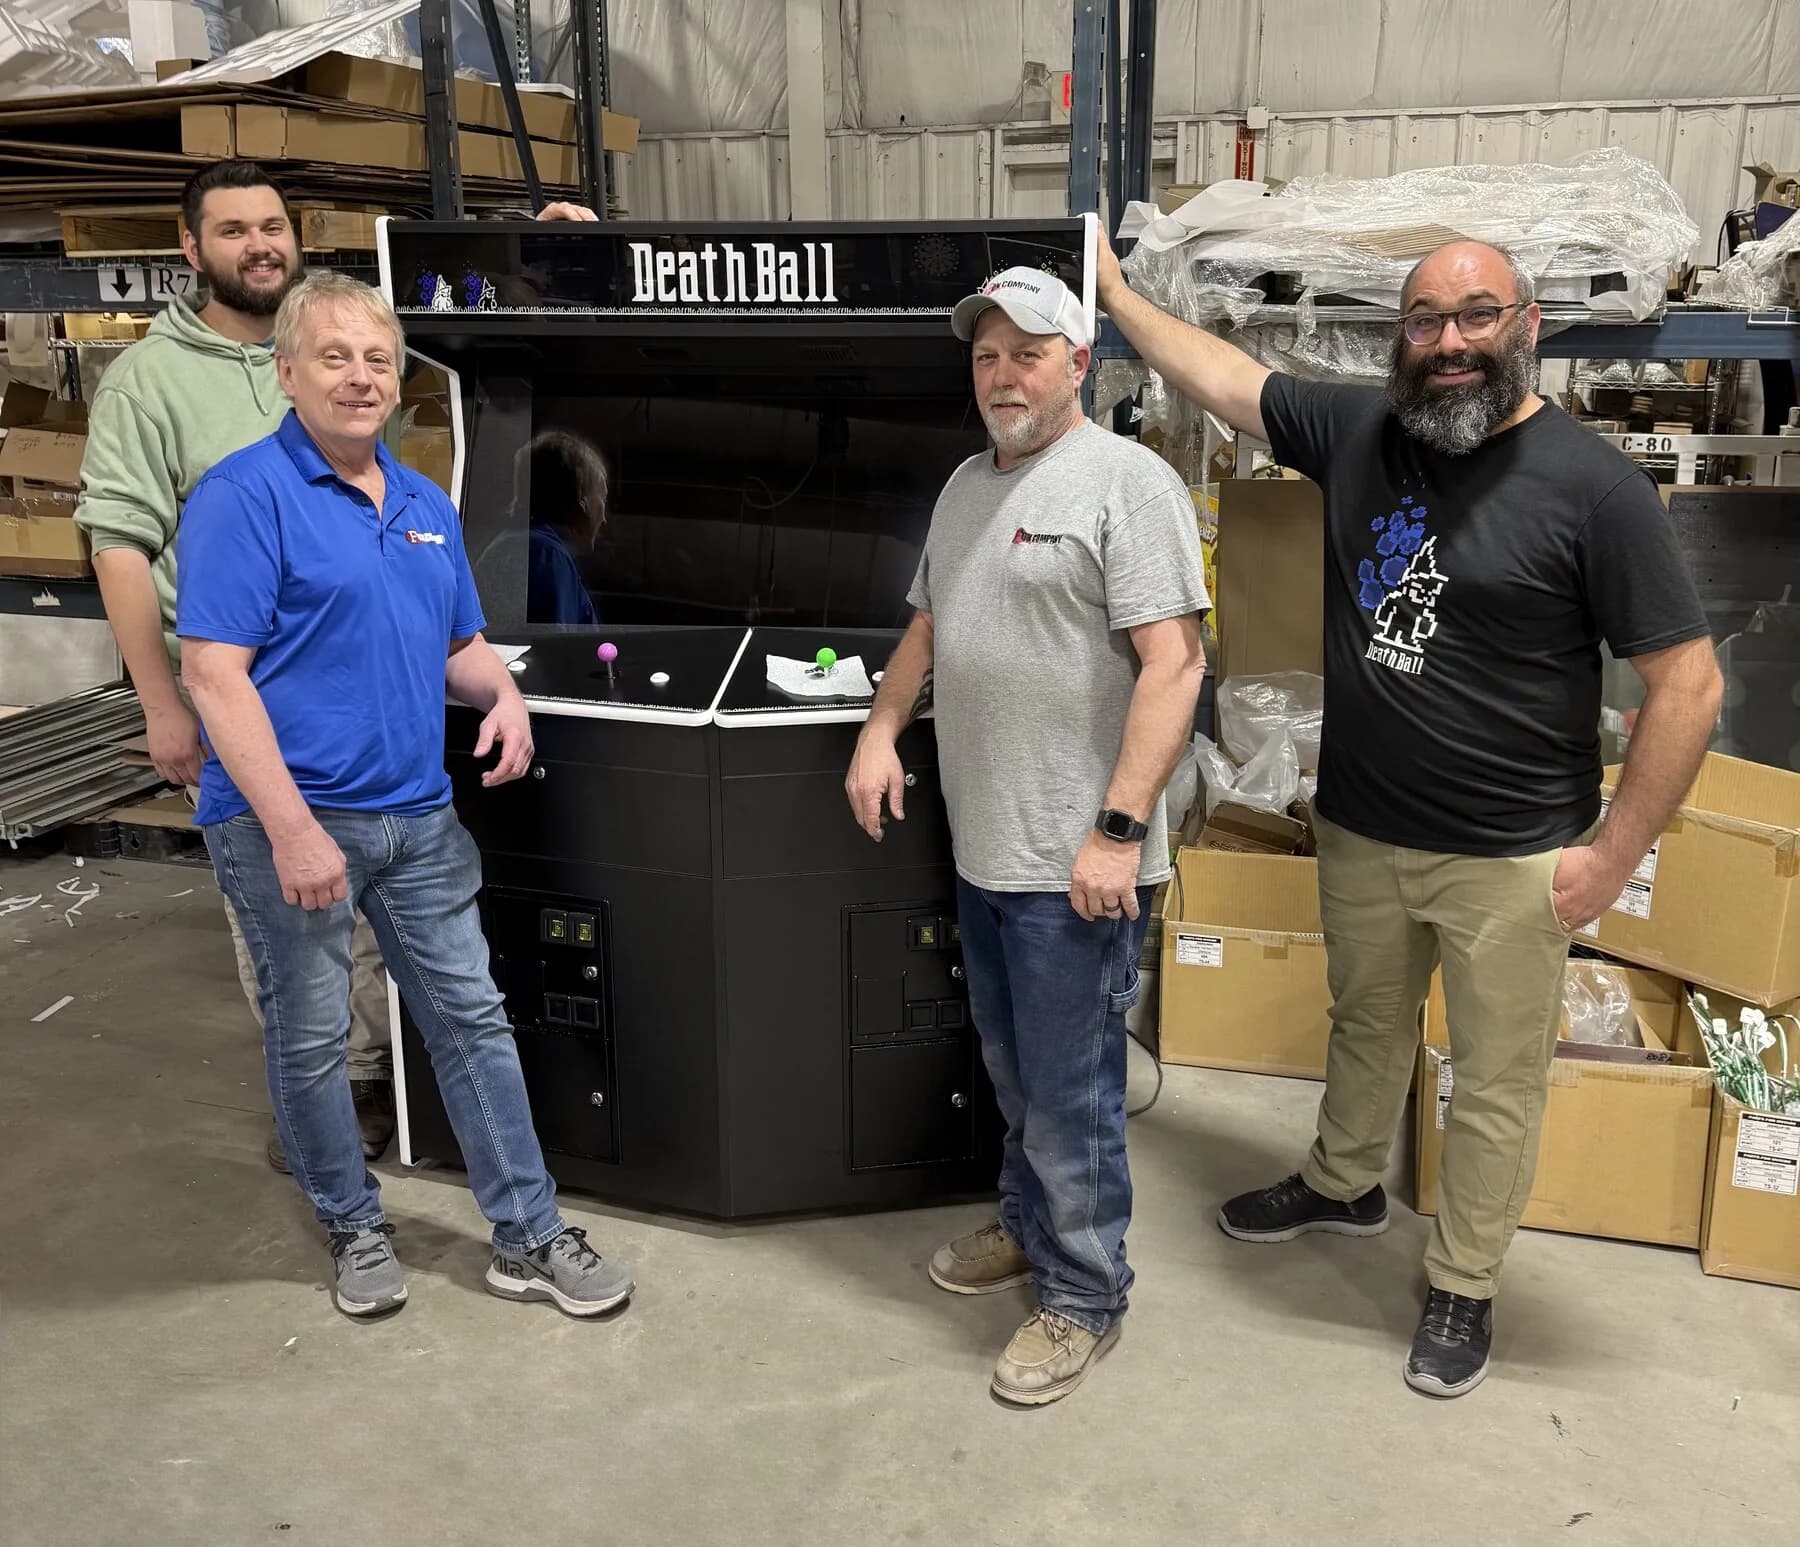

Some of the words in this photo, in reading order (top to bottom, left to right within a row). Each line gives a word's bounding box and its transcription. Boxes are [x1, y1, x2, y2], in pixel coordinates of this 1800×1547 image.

[157, 268, 190, 295] R7
[1001, 280, 1041, 294] COMPANY
[1622, 436, 1672, 451] C-80
[1364, 640, 1425, 675] DeathBall
